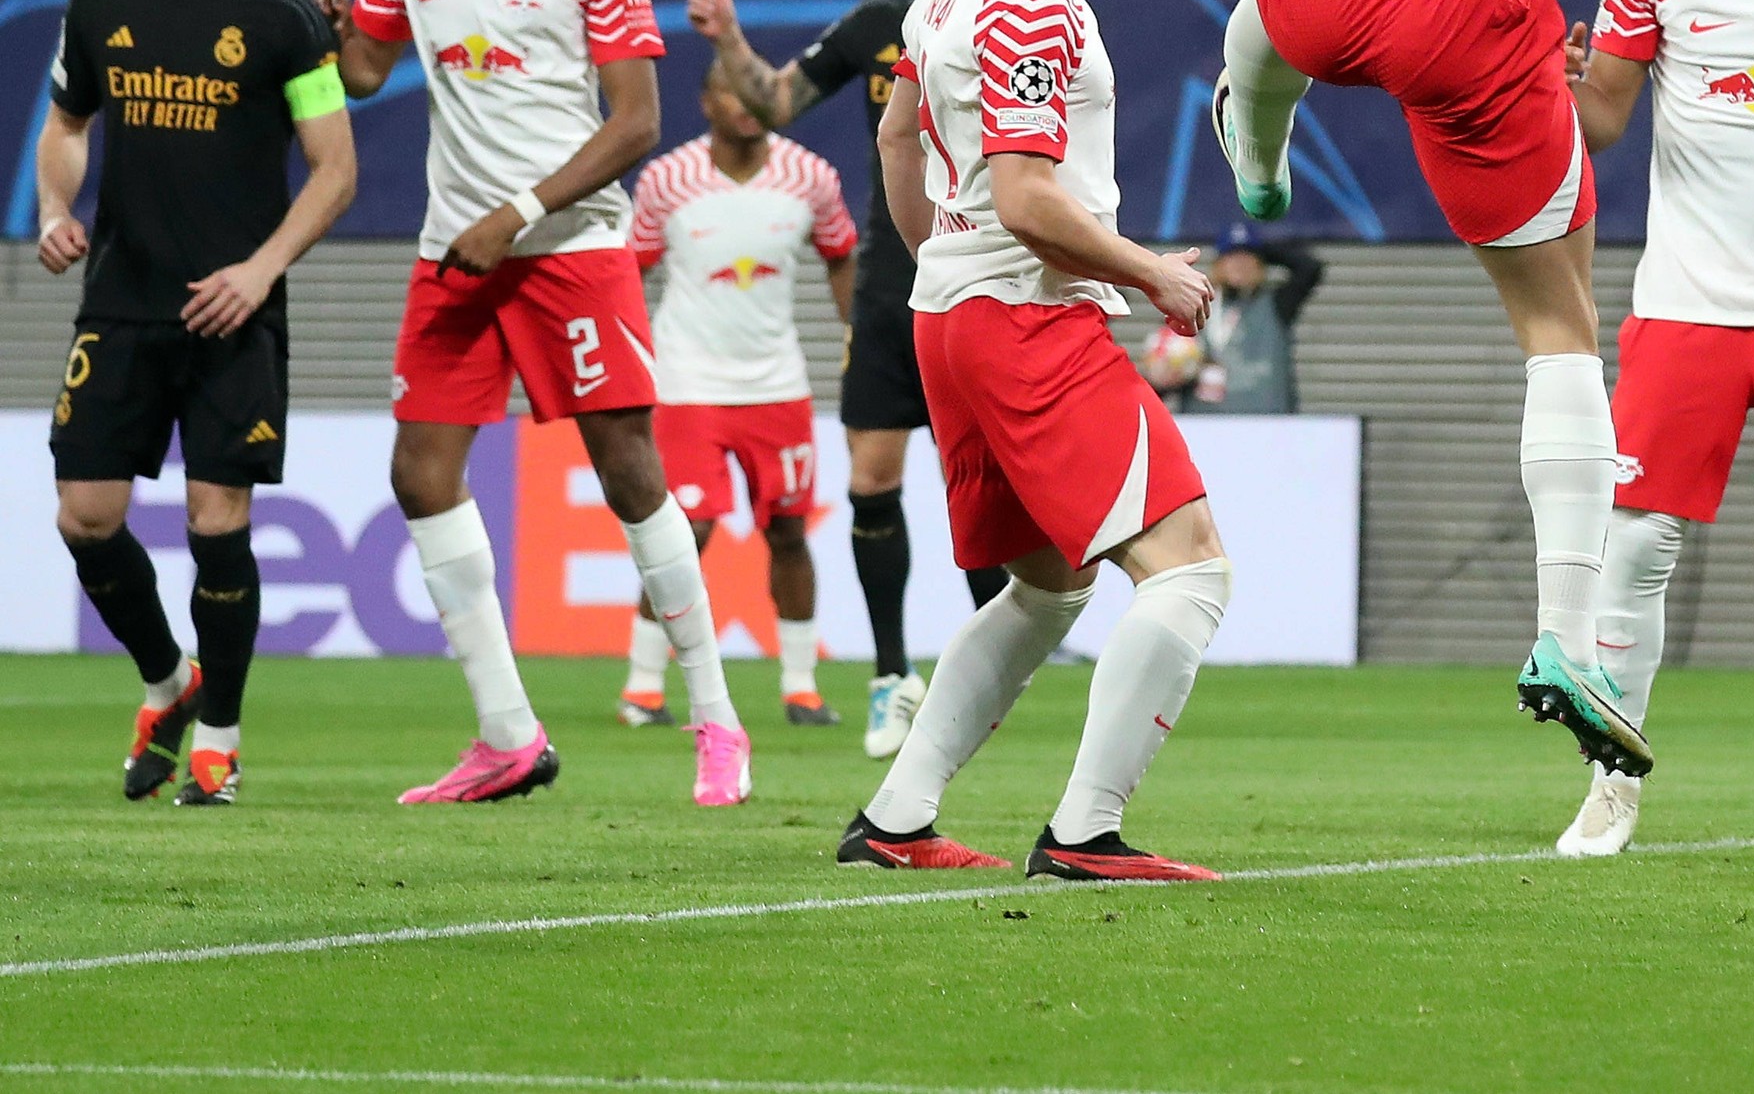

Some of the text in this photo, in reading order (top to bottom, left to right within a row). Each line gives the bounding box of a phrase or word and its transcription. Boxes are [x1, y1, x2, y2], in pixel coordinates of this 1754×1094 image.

[107, 65, 240, 105] Emirates
[123, 100, 219, 132] FLY BETTER
[1000, 114, 1056, 125] FOUNDATION
[65, 333, 101, 388] 6
[566, 316, 606, 380] 2
[779, 442, 814, 494] 17
